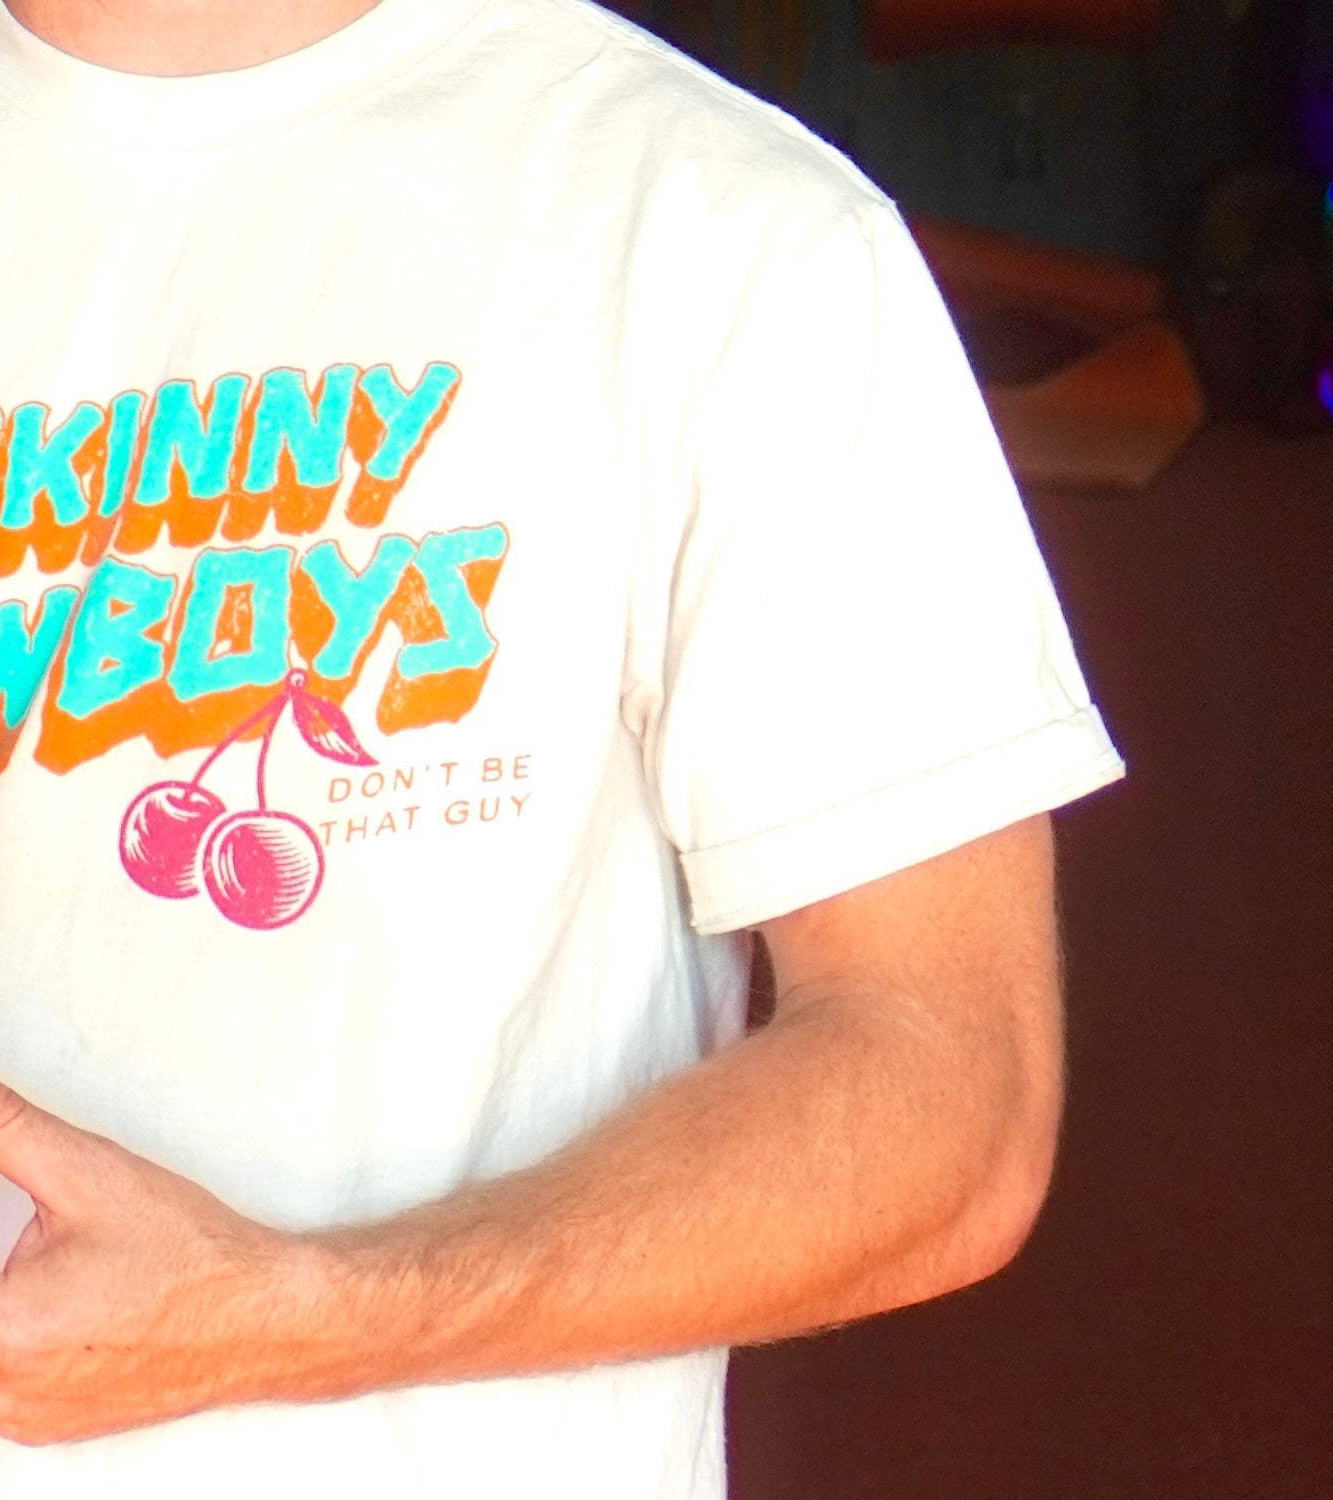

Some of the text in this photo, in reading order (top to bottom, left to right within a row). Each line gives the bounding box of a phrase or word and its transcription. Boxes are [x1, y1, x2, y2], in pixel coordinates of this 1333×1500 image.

[328, 754, 532, 804] DON'T BE
[319, 791, 532, 847] THAT GUY
